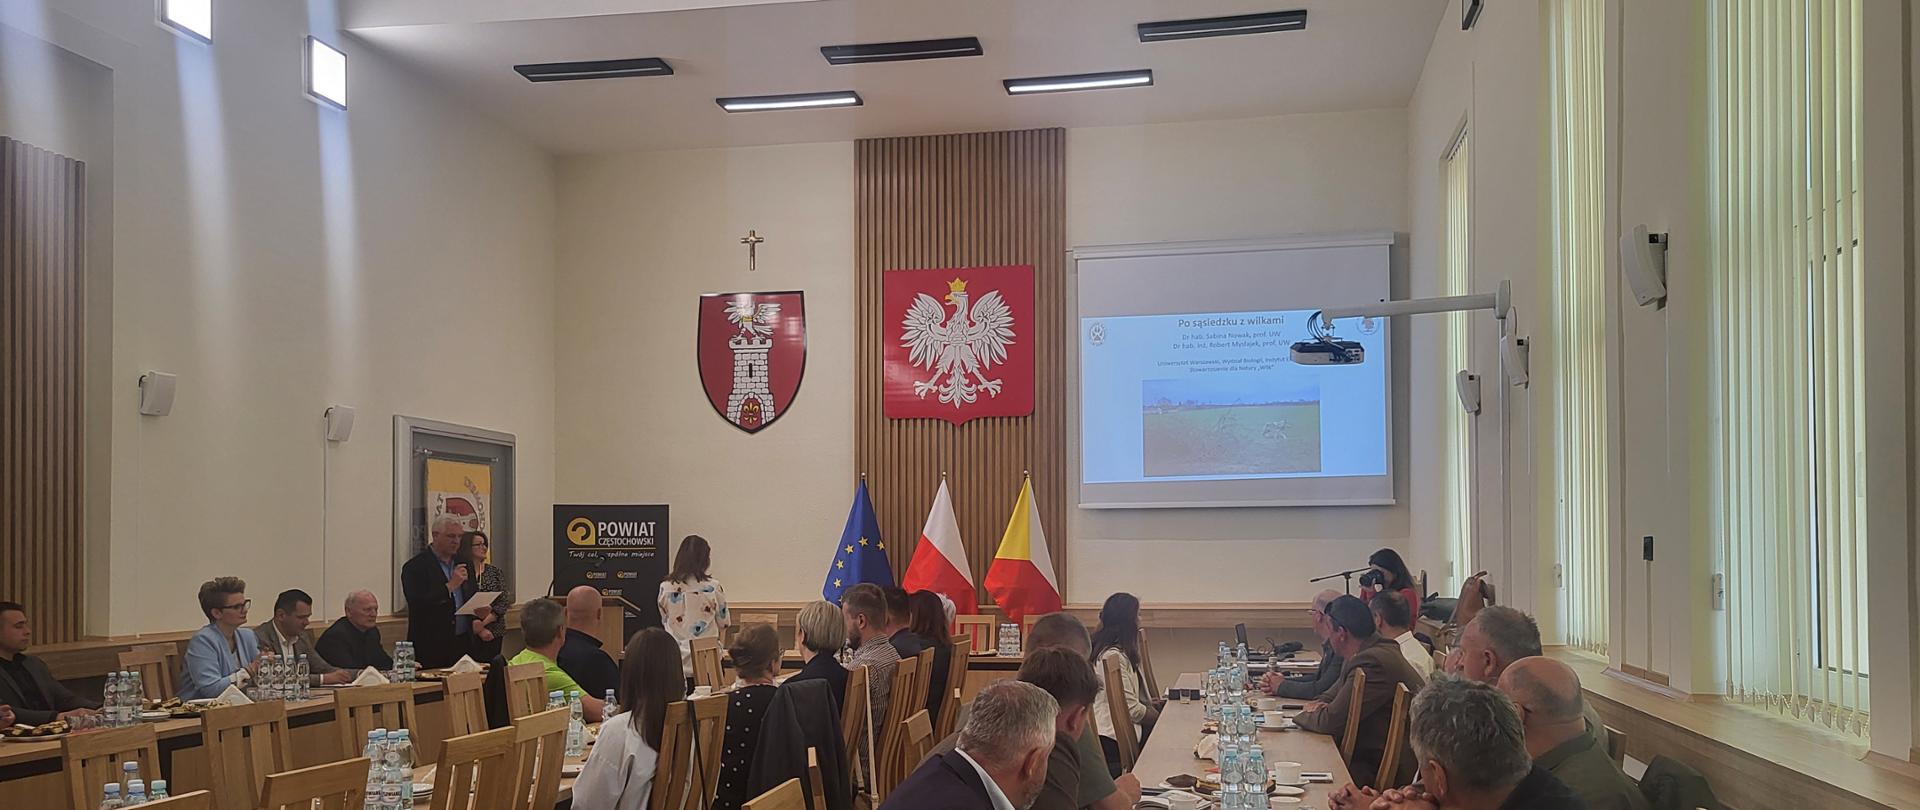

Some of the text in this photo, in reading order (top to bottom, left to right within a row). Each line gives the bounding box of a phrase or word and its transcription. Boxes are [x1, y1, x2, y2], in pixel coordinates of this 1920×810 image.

[1178, 319, 1190, 328] Po
[1193, 317, 1237, 328] sąsiedzku
[1247, 315, 1284, 325] wilkami
[598, 521, 656, 537] POWIAT
[598, 537, 654, 547] CZĘSTOCHOWSKI
